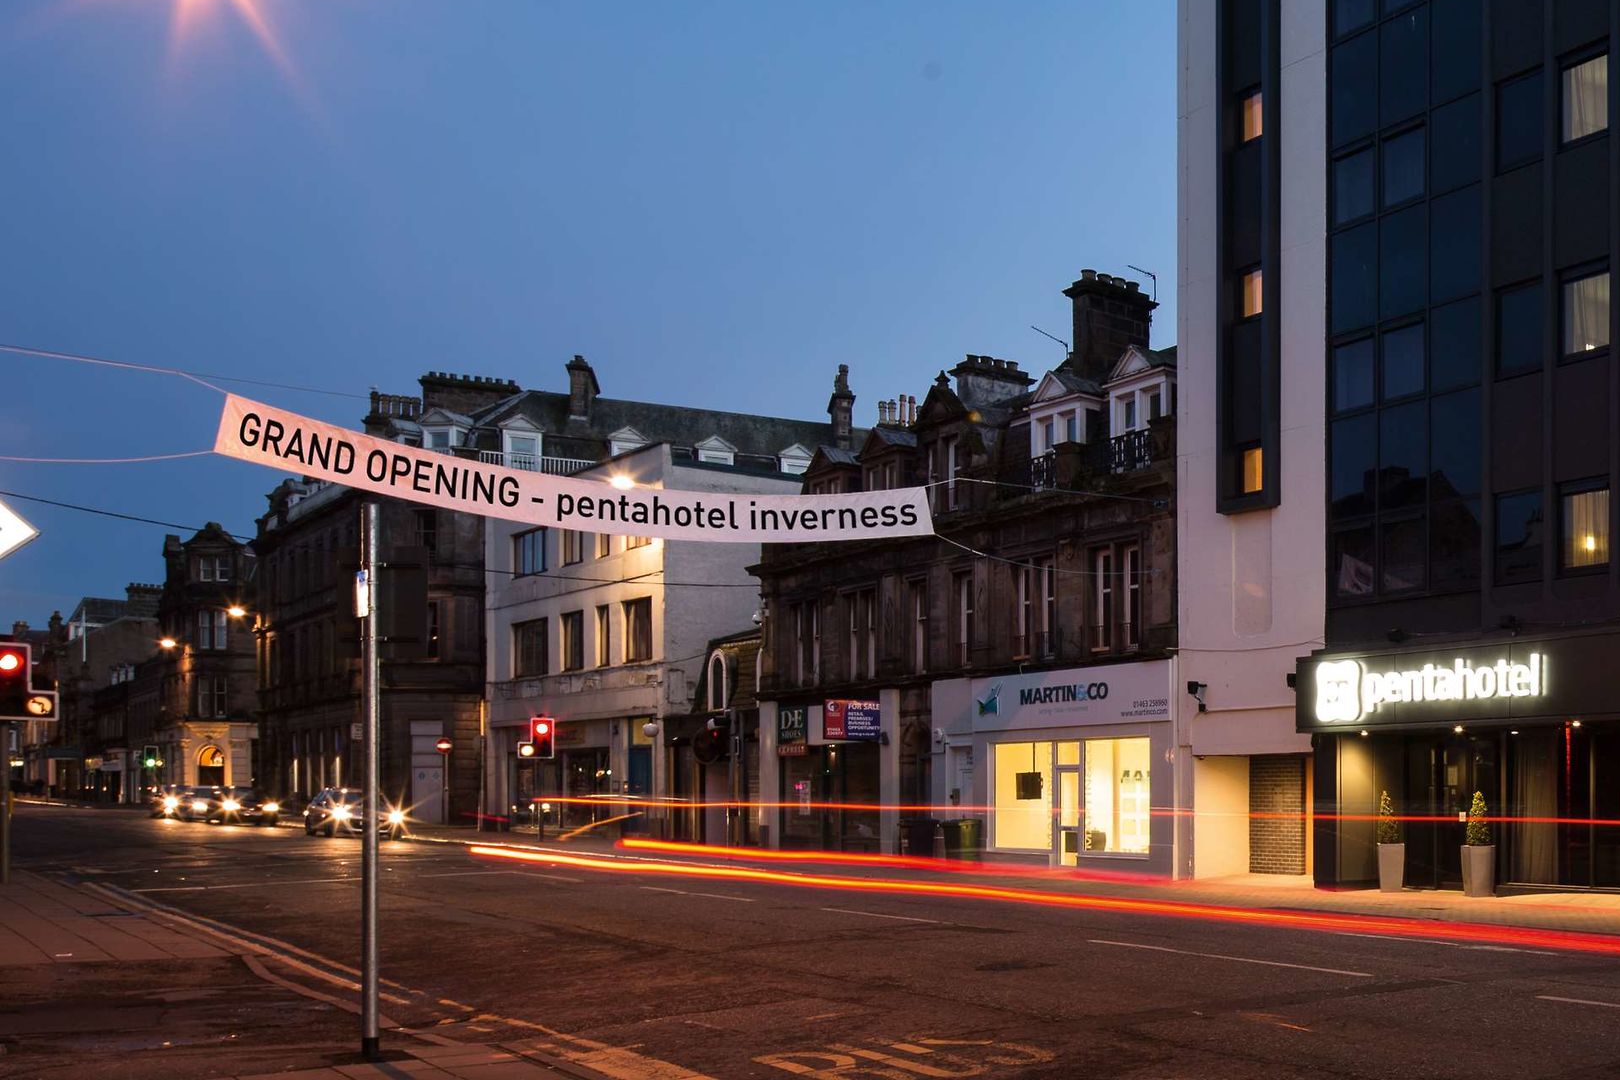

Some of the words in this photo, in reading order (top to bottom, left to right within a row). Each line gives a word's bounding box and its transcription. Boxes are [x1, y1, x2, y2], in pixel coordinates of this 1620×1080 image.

[239, 413, 356, 475] GRAND
[366, 449, 521, 508] OPENING
[556, 493, 740, 531] pentahotel
[750, 502, 918, 531] inverness
[1020, 682, 1109, 706] MARTIN&CO
[1363, 653, 1541, 713] pentahotel
[847, 703, 863, 711] FOR
[863, 703, 880, 711] SALE
